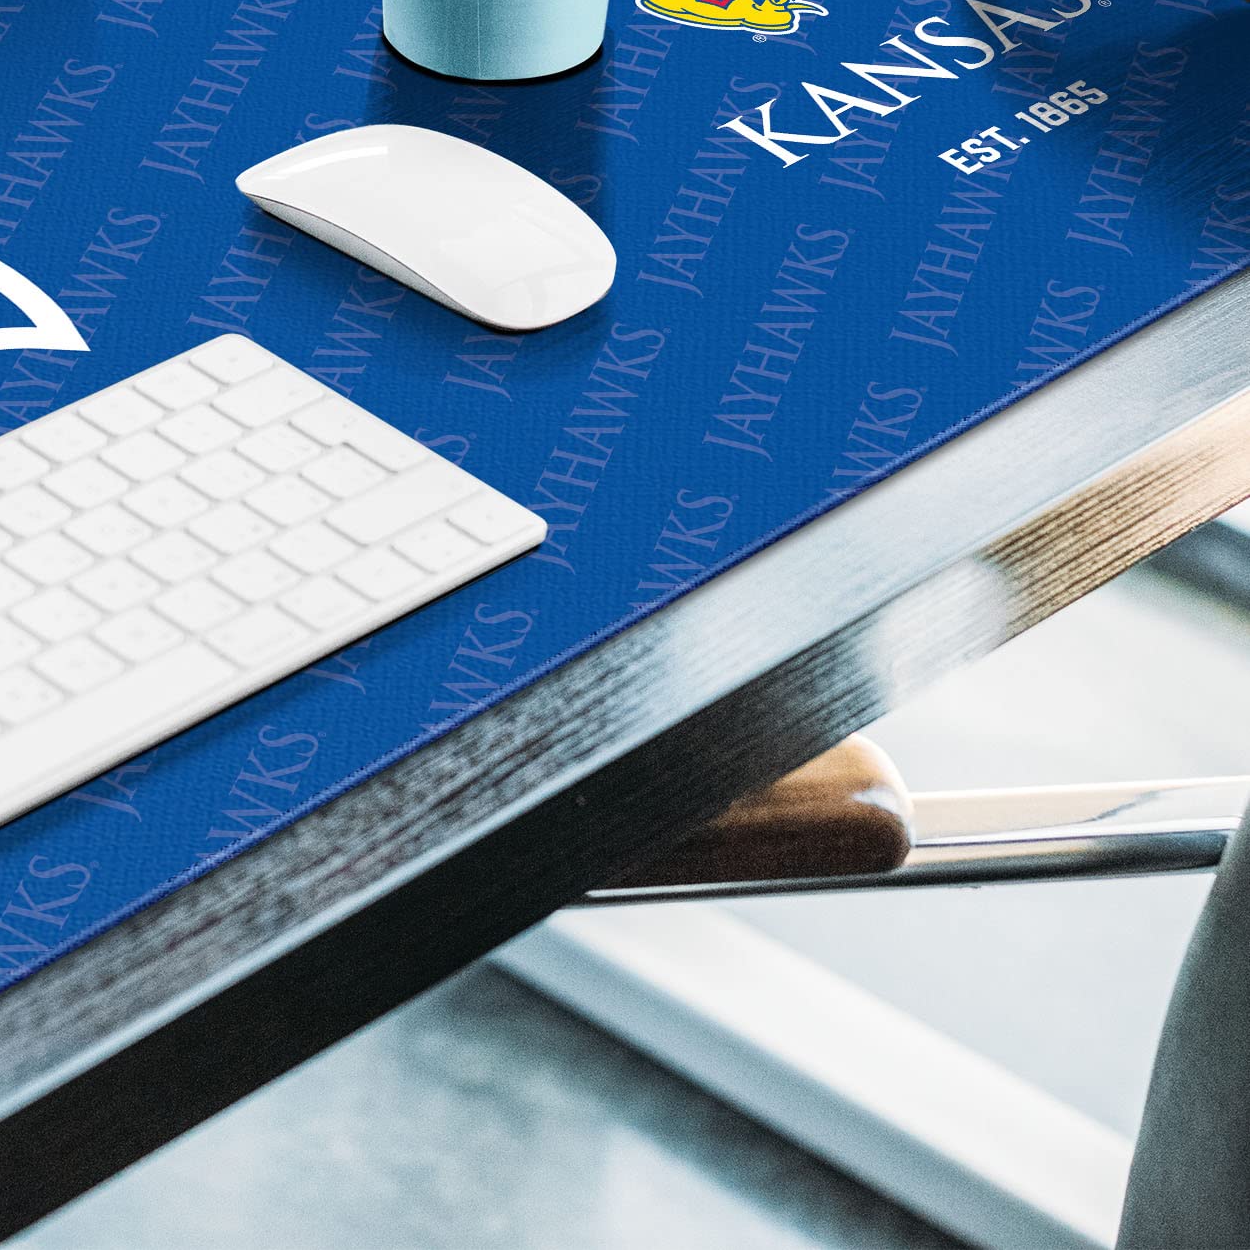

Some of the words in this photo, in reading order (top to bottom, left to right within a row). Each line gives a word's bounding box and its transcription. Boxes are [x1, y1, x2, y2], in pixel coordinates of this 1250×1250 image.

[574, 8, 682, 146] JAYHA
[937, 126, 1031, 175] EST.
[1014, 79, 1109, 133] 1865
[1065, 41, 1189, 257] JAYHAWKS
[185, 208, 295, 340] JAYH
[702, 223, 849, 462] JAYHAWKS
